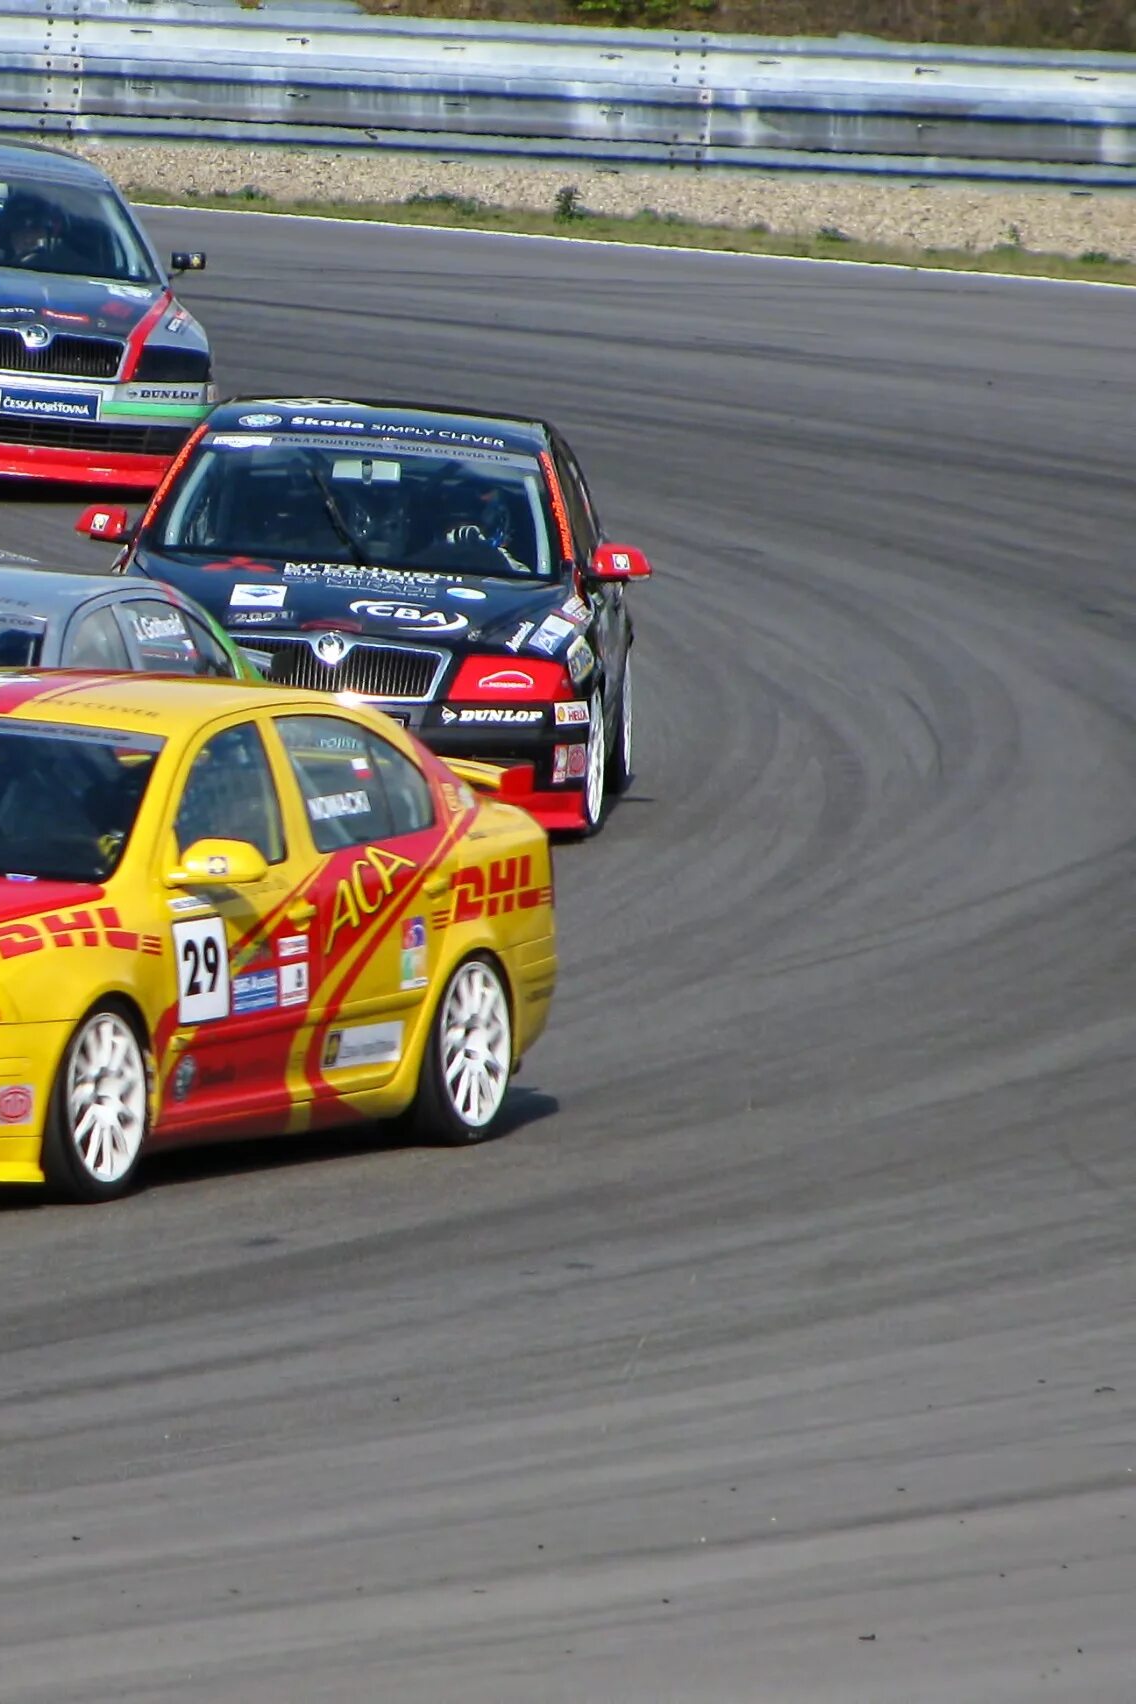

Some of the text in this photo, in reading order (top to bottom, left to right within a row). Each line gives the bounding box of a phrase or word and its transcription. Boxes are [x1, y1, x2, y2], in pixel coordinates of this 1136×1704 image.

[2, 396, 34, 410] ČESKÁ
[140, 389, 200, 400] DUNLOP
[370, 422, 435, 437] SIMPLY
[438, 430, 506, 448] CLEVER
[366, 605, 449, 626] CBA
[458, 708, 544, 723] DUNLOP
[325, 845, 417, 954] ACA
[450, 854, 542, 923] DHL
[183, 936, 220, 997] 29
